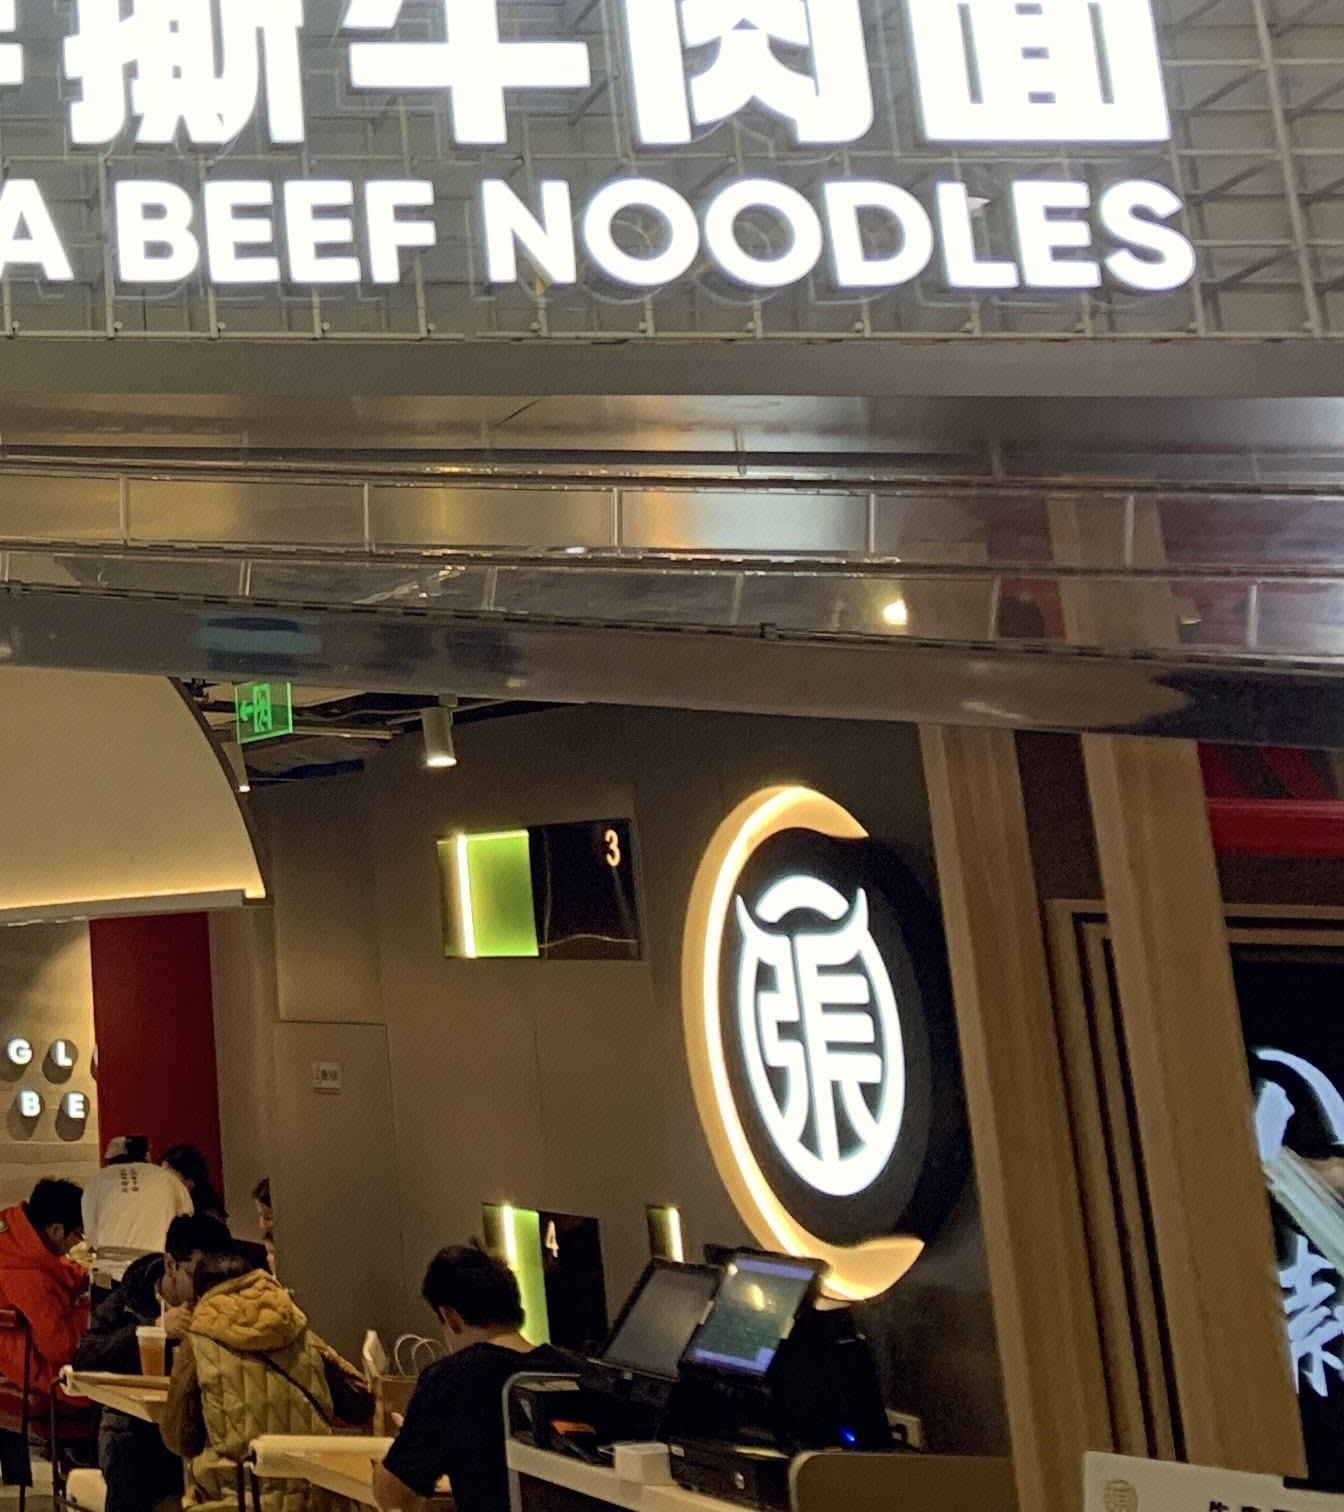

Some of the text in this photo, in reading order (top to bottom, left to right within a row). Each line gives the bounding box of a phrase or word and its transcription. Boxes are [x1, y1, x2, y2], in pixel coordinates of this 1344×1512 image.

[114, 179, 436, 284] BEEF
[481, 177, 1196, 290] NOODLES
[605, 829, 621, 867] 3
[545, 1220, 559, 1258] 4
